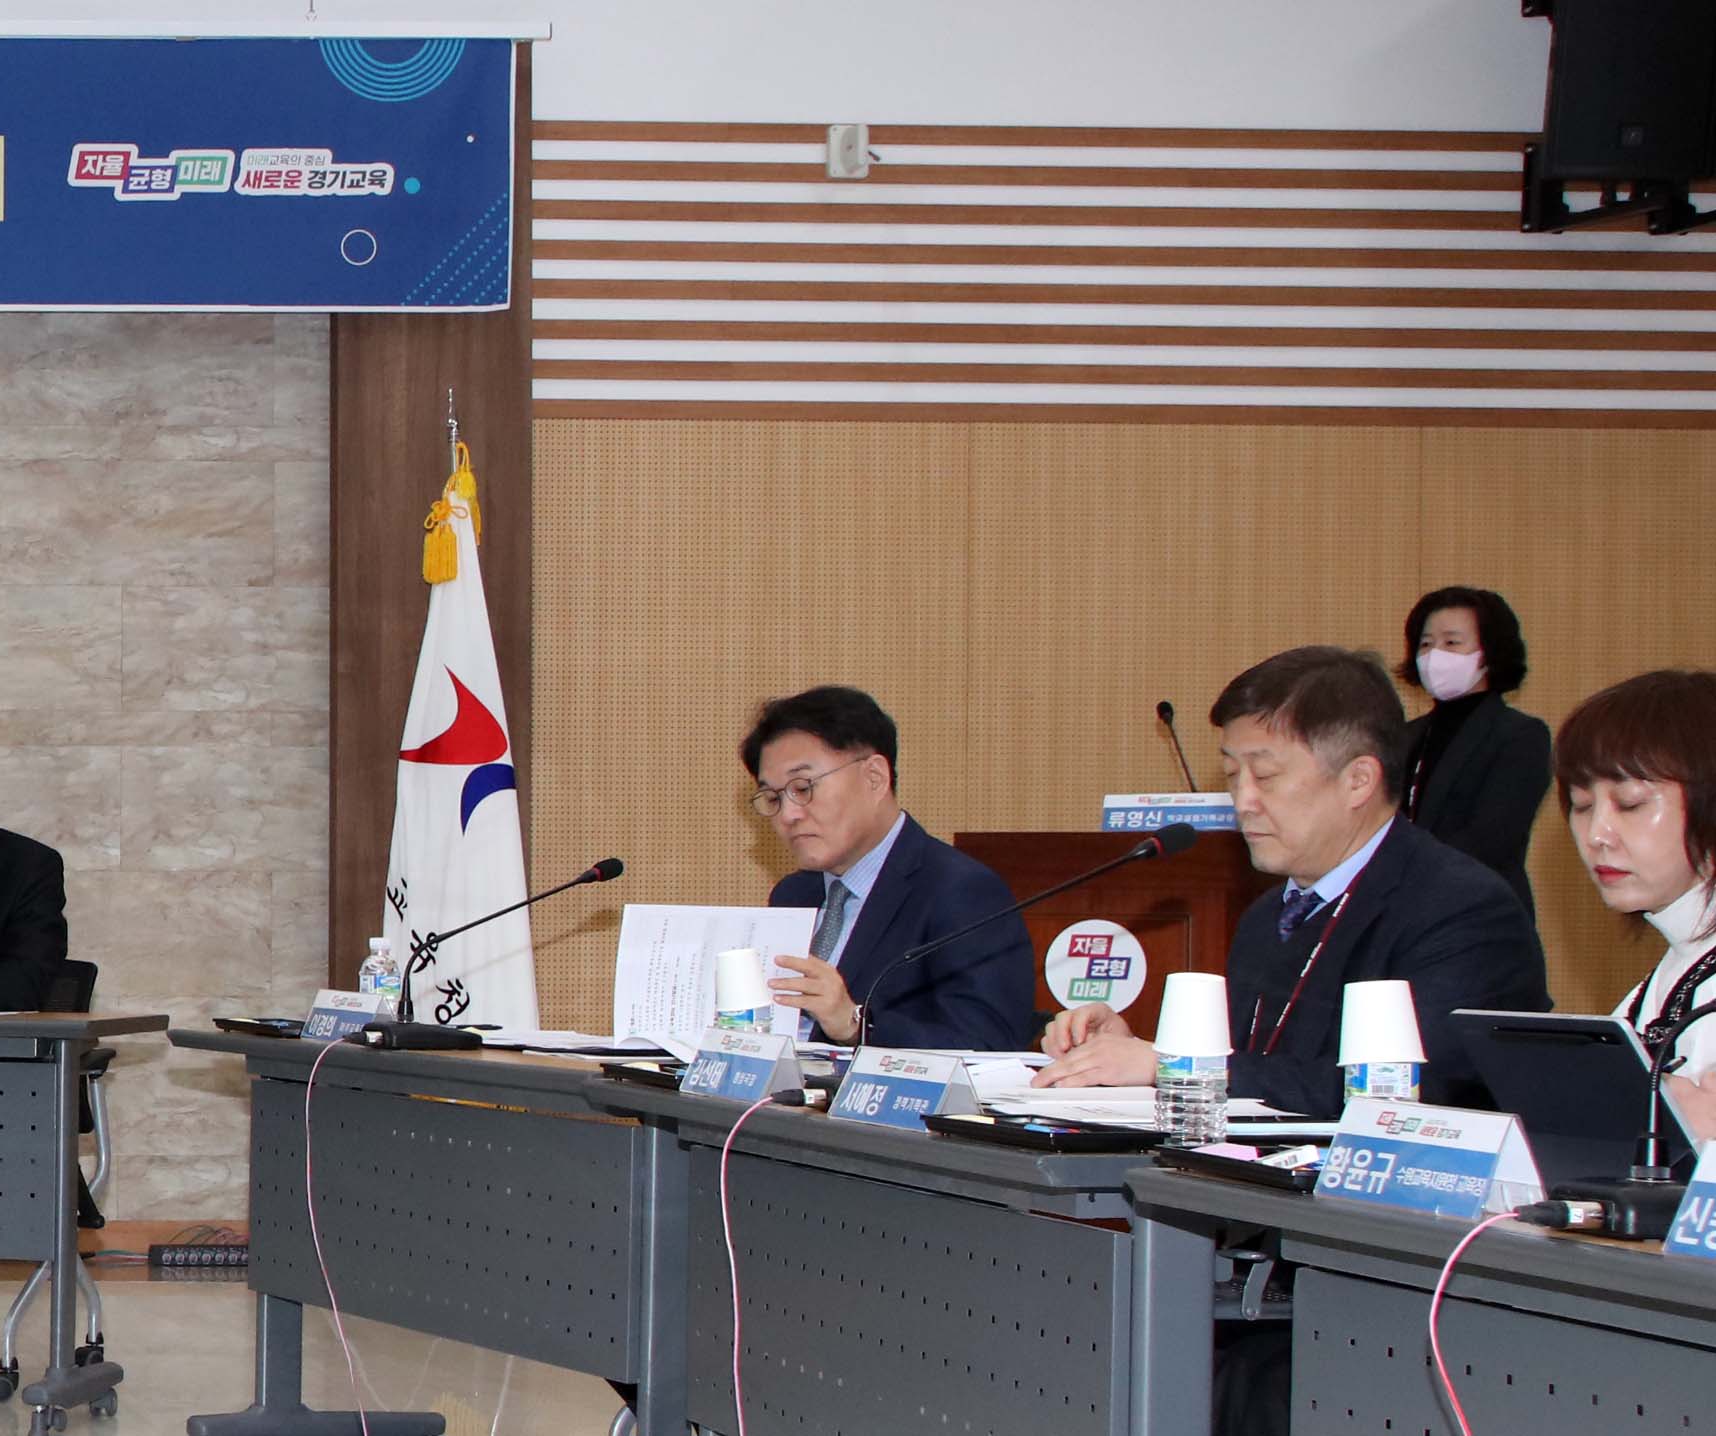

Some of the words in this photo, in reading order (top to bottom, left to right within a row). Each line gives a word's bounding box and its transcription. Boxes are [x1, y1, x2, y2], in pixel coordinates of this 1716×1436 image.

[81, 153, 126, 176] 자율
[127, 168, 172, 190] 균형
[178, 158, 223, 182] 미래
[241, 169, 303, 189] 새로운
[306, 168, 388, 190] 경기교육
[1108, 810, 1163, 828] 류영신
[1071, 936, 1109, 956] 자율
[1089, 958, 1129, 978] 균형
[1071, 979, 1109, 999] 미래
[1322, 1145, 1398, 1195] 황윤규
